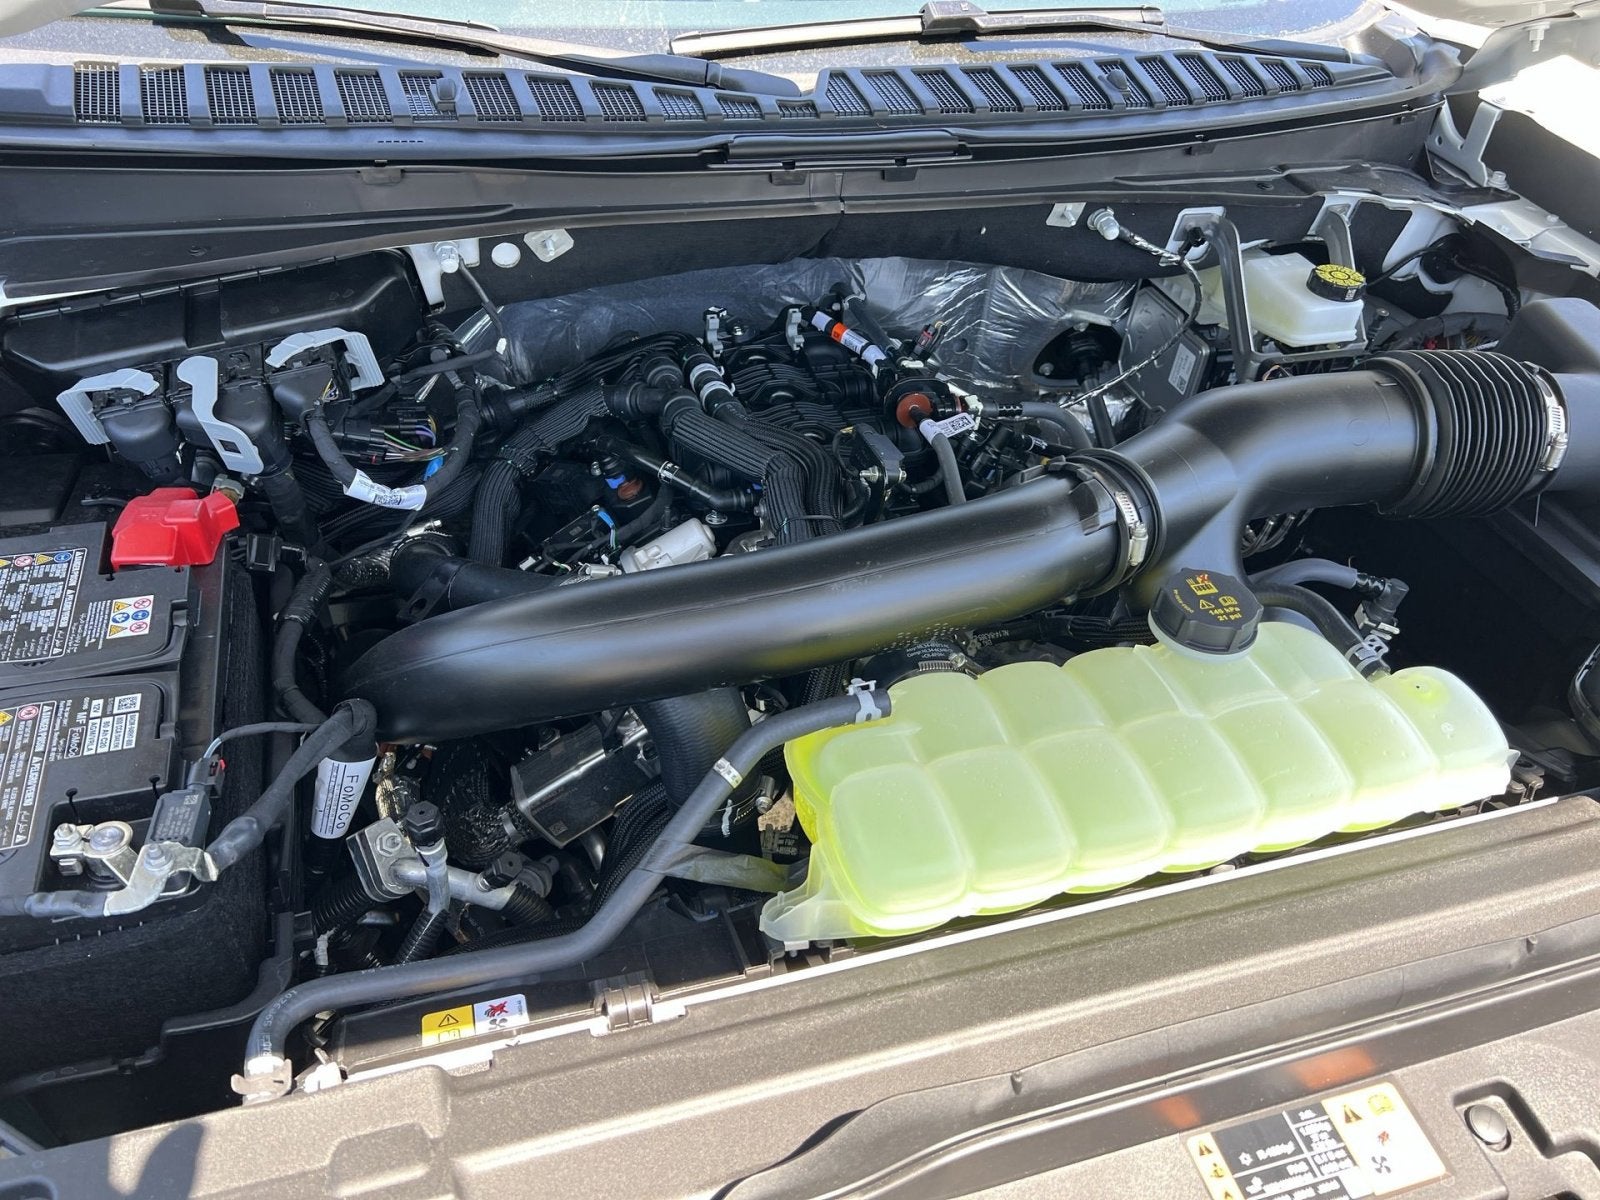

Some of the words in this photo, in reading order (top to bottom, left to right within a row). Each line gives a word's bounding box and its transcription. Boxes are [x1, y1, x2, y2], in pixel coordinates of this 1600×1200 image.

[91, 702, 101, 713] 12V
[67, 727, 82, 757] FoMoCo
[336, 775, 360, 830] FoMoCo
